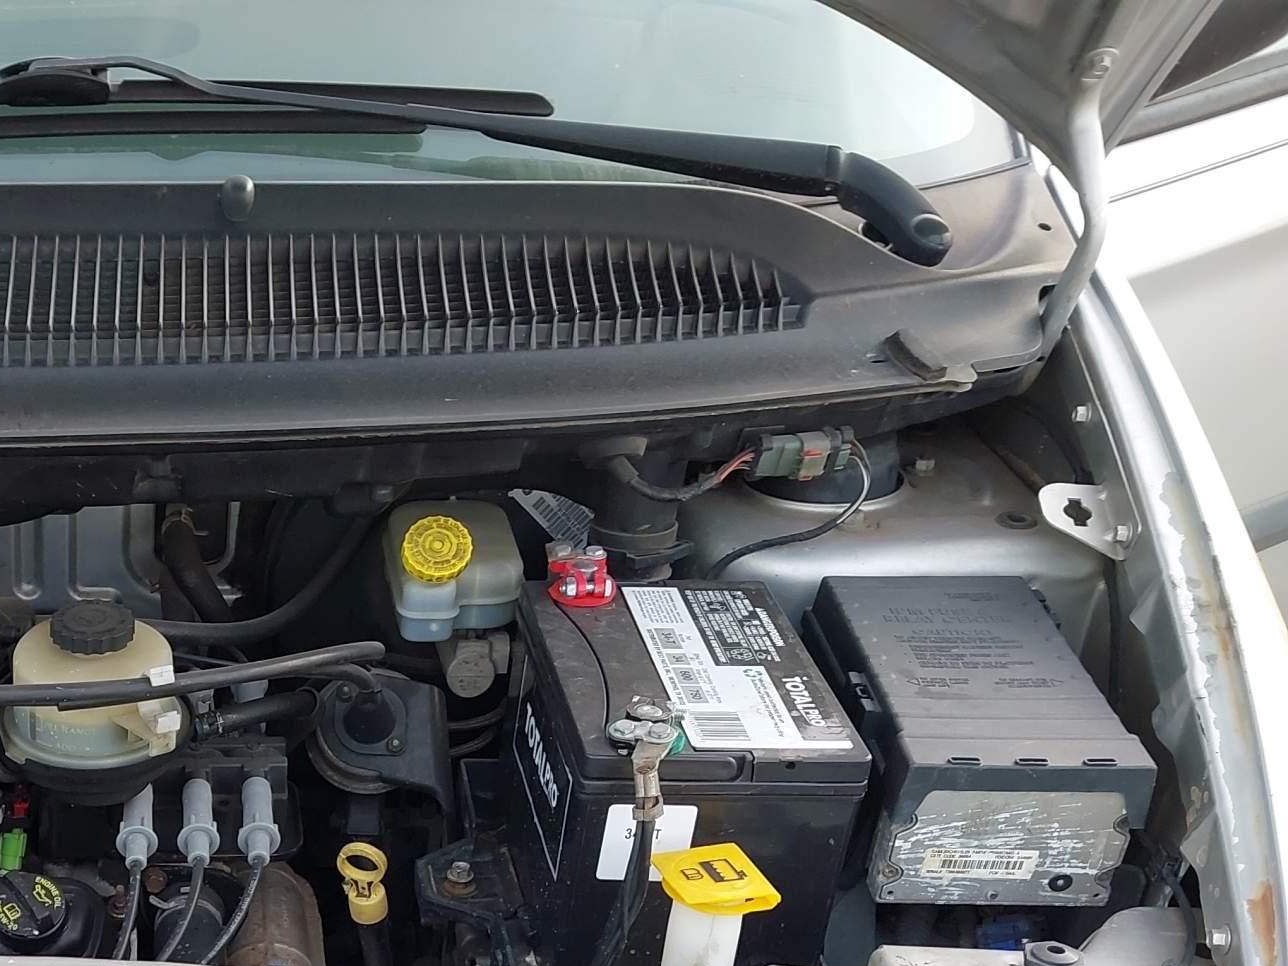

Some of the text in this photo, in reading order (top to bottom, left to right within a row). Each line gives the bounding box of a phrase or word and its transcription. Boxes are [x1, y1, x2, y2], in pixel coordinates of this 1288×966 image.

[782, 676, 825, 727] TOTALPRO
[524, 702, 560, 808] TOTALPRO
[35, 876, 62, 909] ENGINE OIL
